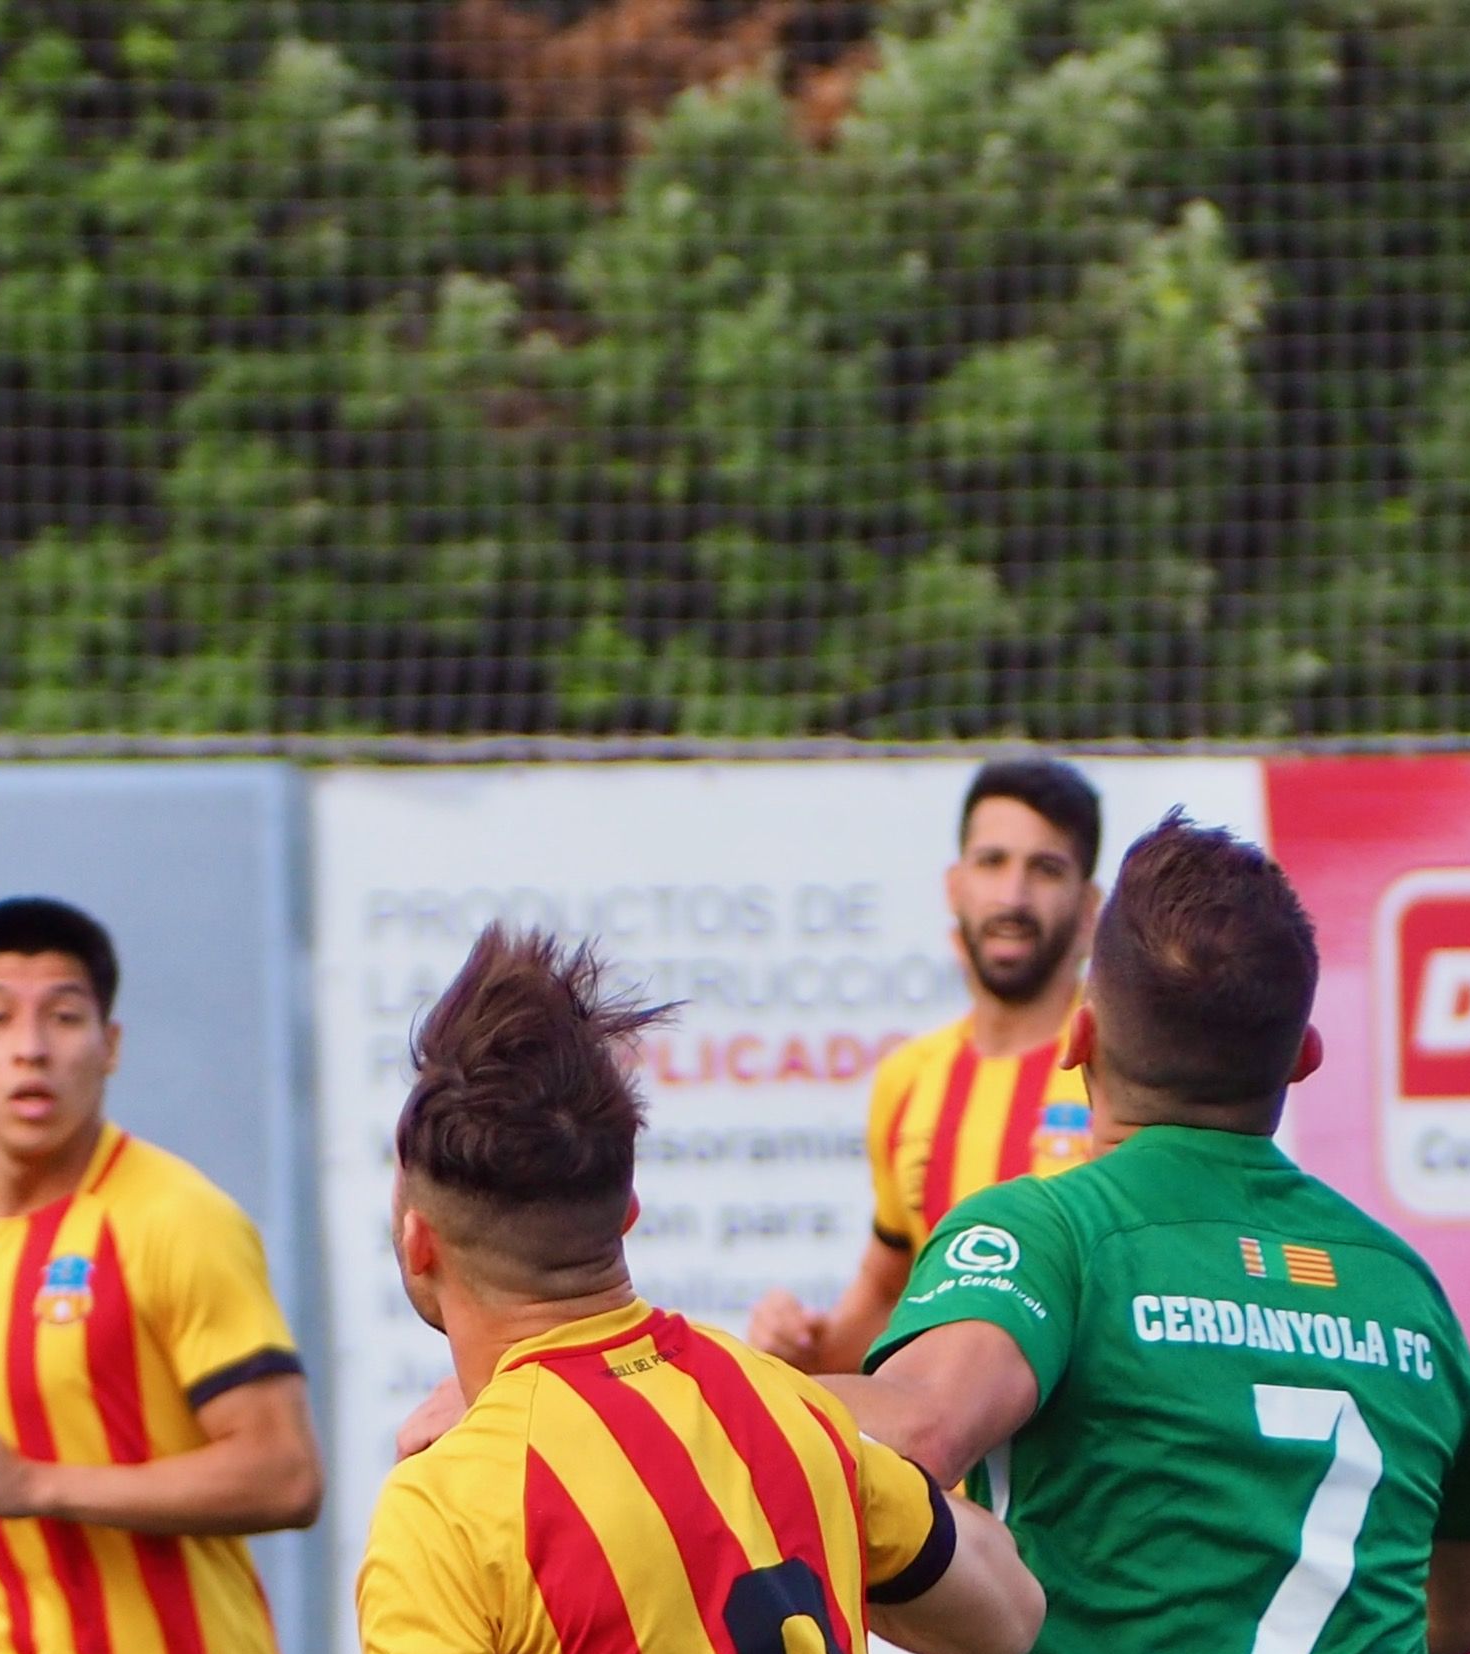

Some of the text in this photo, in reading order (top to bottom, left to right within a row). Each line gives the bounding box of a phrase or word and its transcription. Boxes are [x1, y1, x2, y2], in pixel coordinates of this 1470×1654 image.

[796, 885, 880, 937] DE
[1132, 1294, 1435, 1382] CERDANYOLA FC
